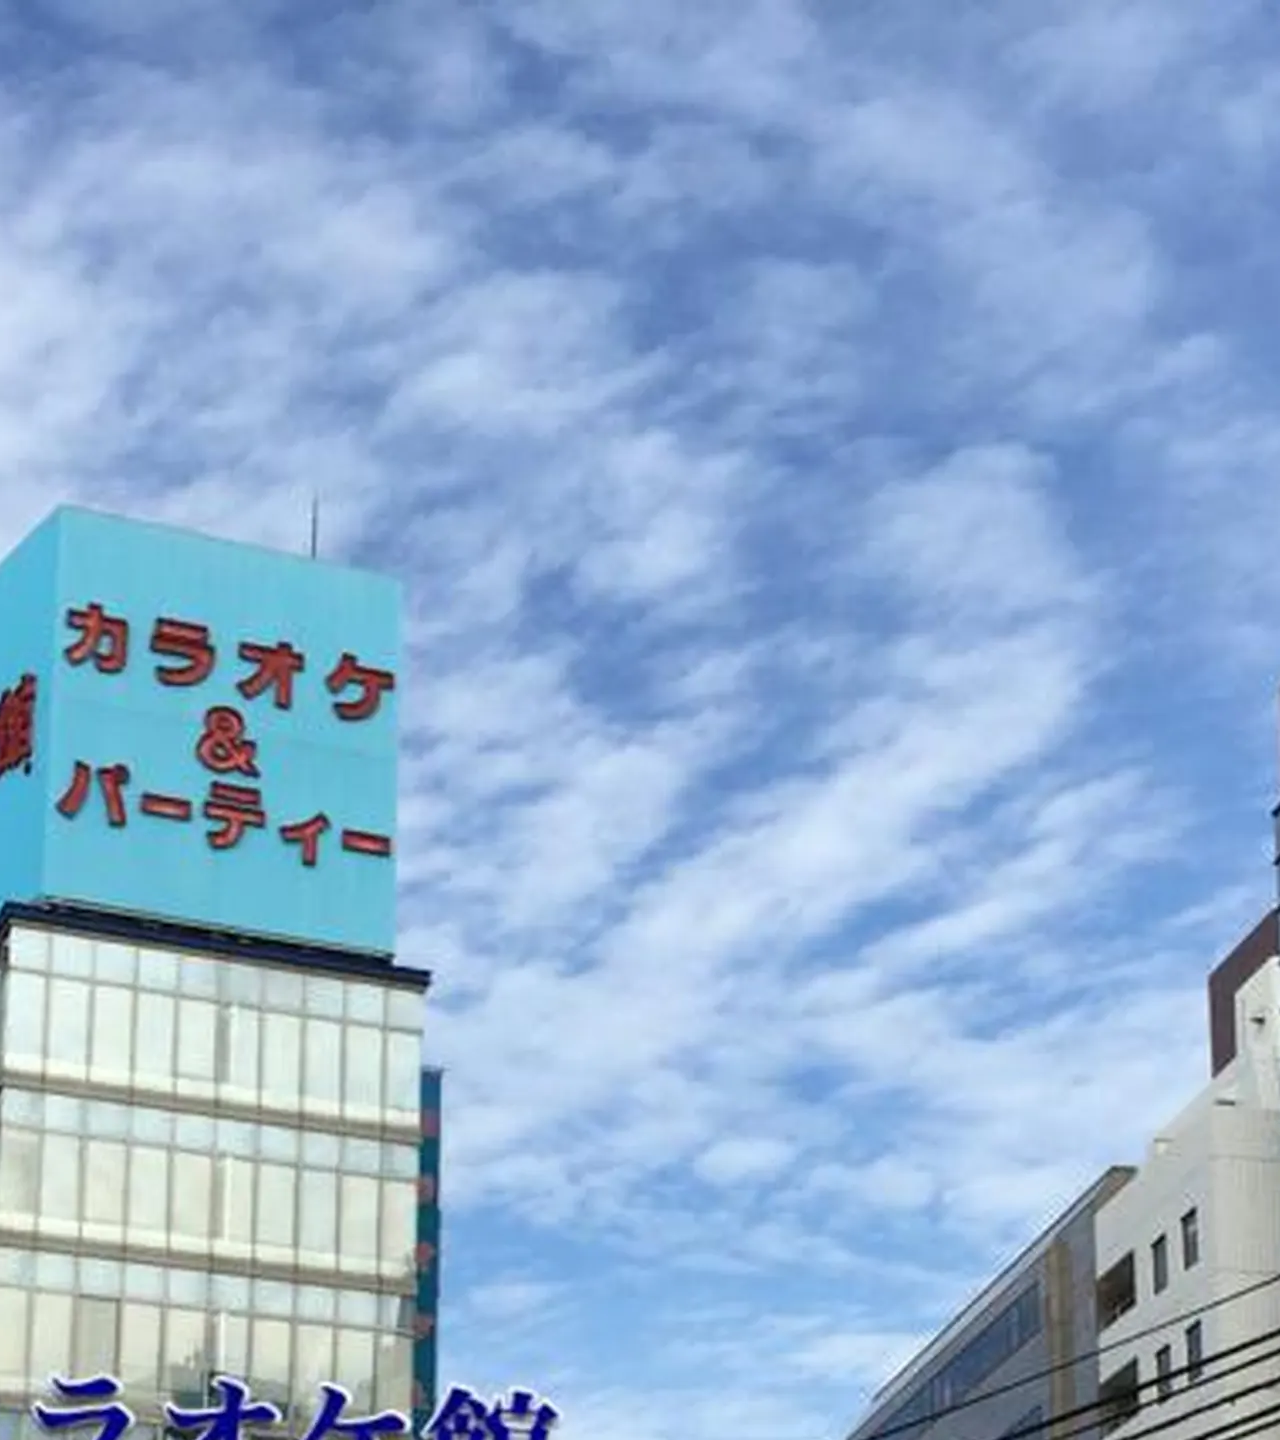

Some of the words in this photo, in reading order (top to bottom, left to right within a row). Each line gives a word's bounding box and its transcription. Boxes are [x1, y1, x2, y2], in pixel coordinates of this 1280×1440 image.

[63, 603, 396, 722] カラオケ
[195, 705, 262, 778] &
[56, 760, 393, 867] パーティー
